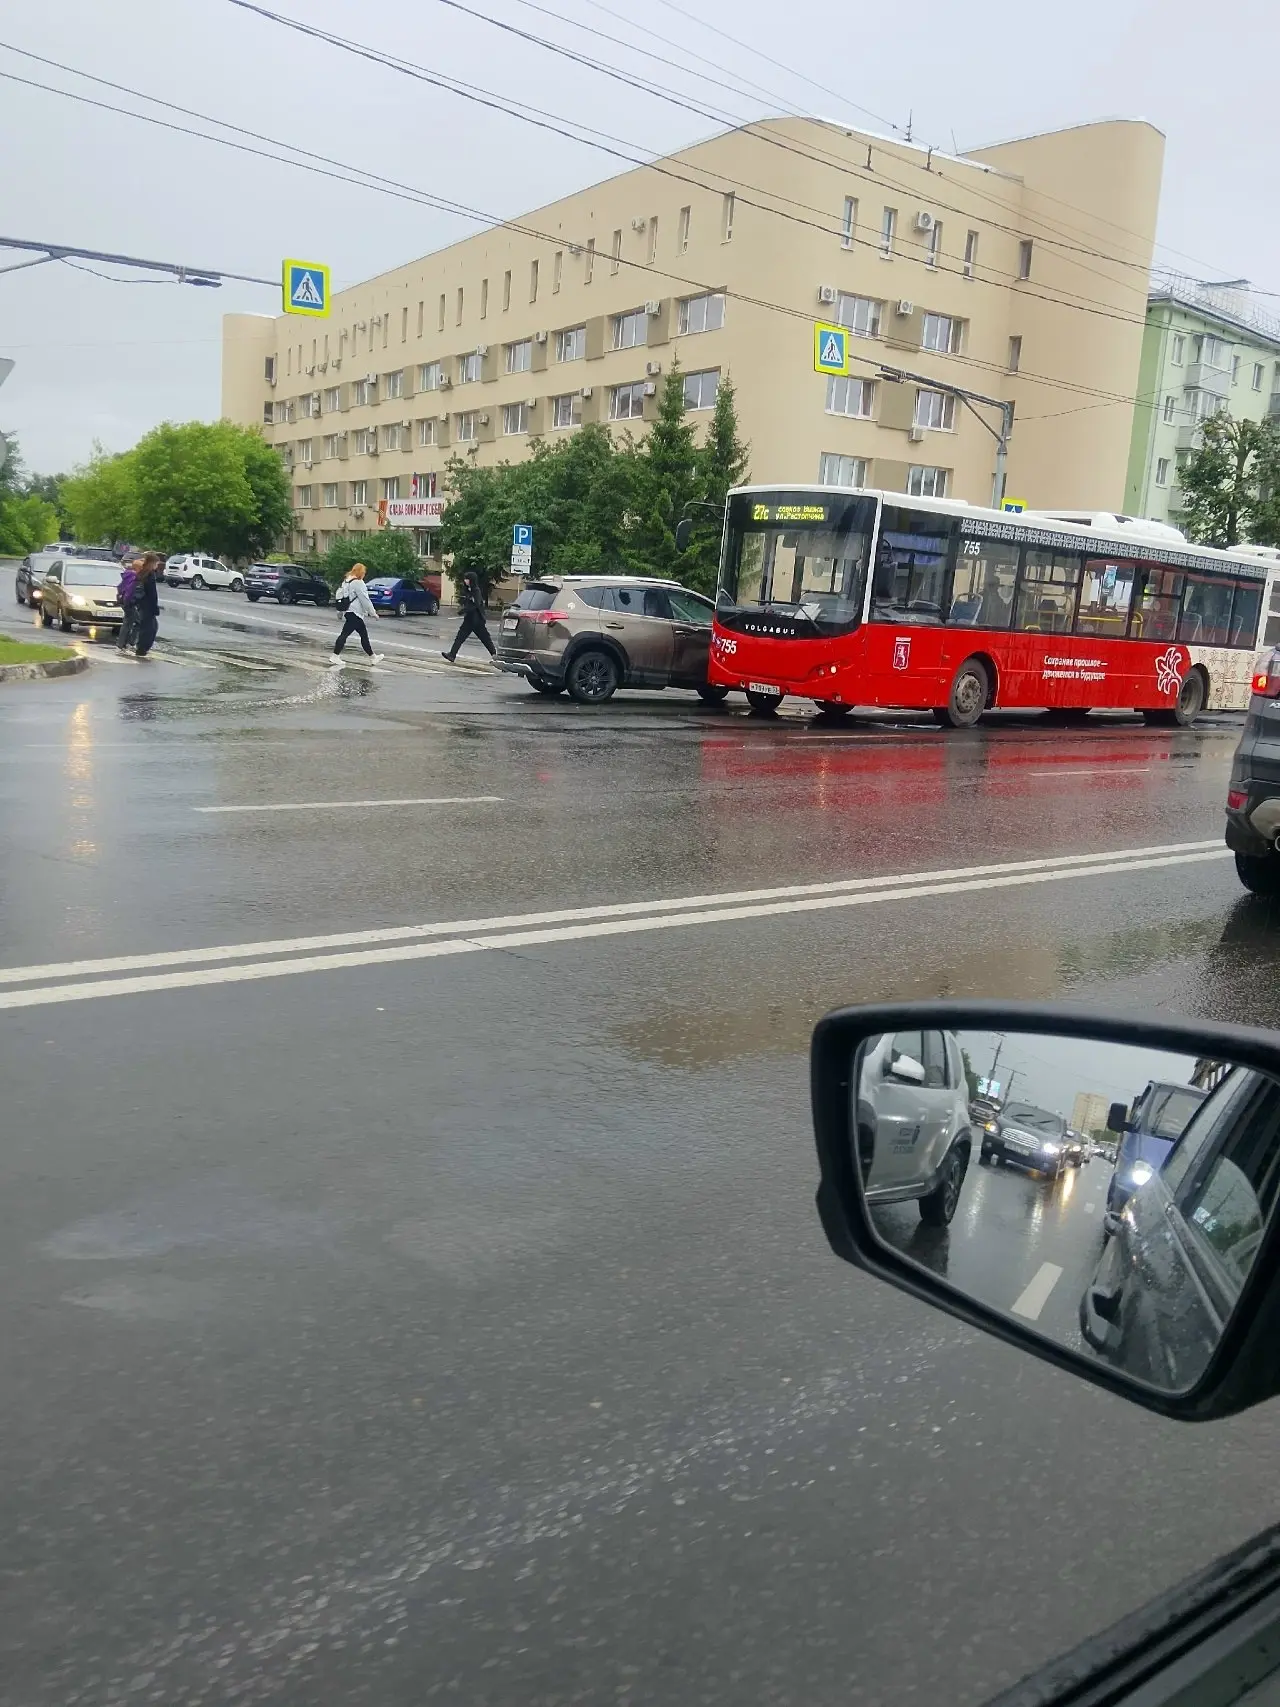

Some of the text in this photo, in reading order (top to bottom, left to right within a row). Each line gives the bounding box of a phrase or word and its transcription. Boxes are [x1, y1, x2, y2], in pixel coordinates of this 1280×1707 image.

[518, 527, 529, 544] P
[964, 540, 980, 555] 755
[745, 623, 795, 635] VOLGABUS
[721, 638, 737, 654] 755
